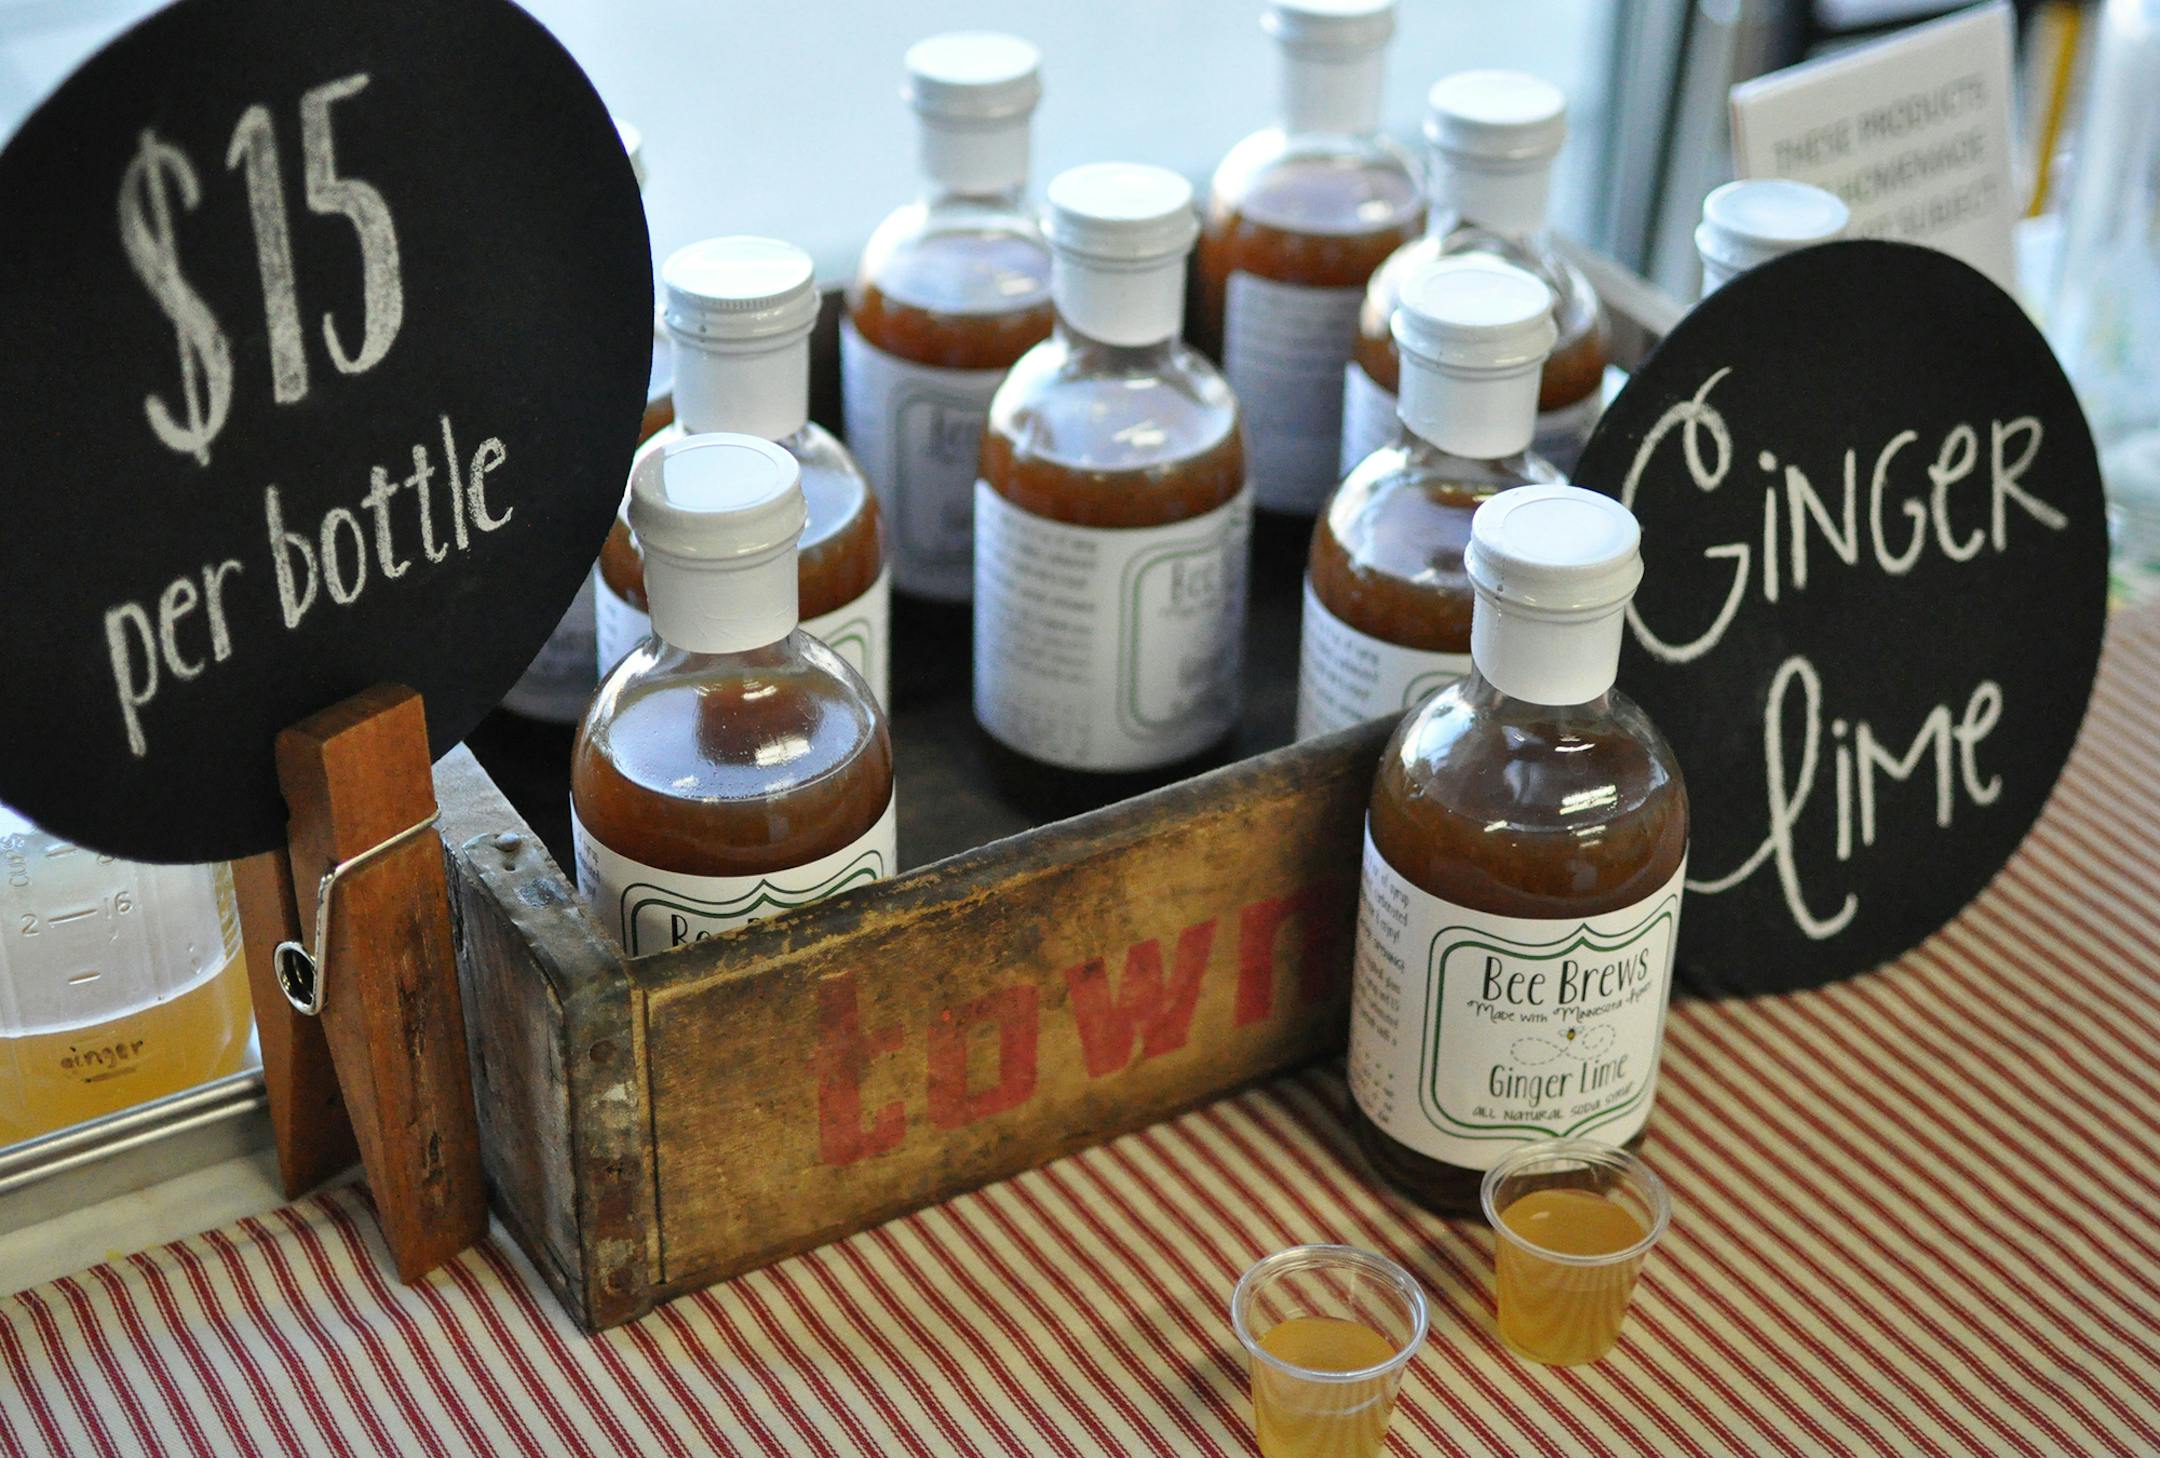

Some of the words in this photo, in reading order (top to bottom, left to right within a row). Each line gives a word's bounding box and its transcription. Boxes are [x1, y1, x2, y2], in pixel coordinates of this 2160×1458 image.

[117, 72, 404, 466] $15
[104, 558, 244, 757] per
[265, 415, 513, 629] bottle
[1482, 956, 1546, 1006] Bee
[1558, 948, 1649, 1005] Brews
[1489, 1064, 1572, 1107] Ginger
[1580, 1054, 1628, 1094] Lime
